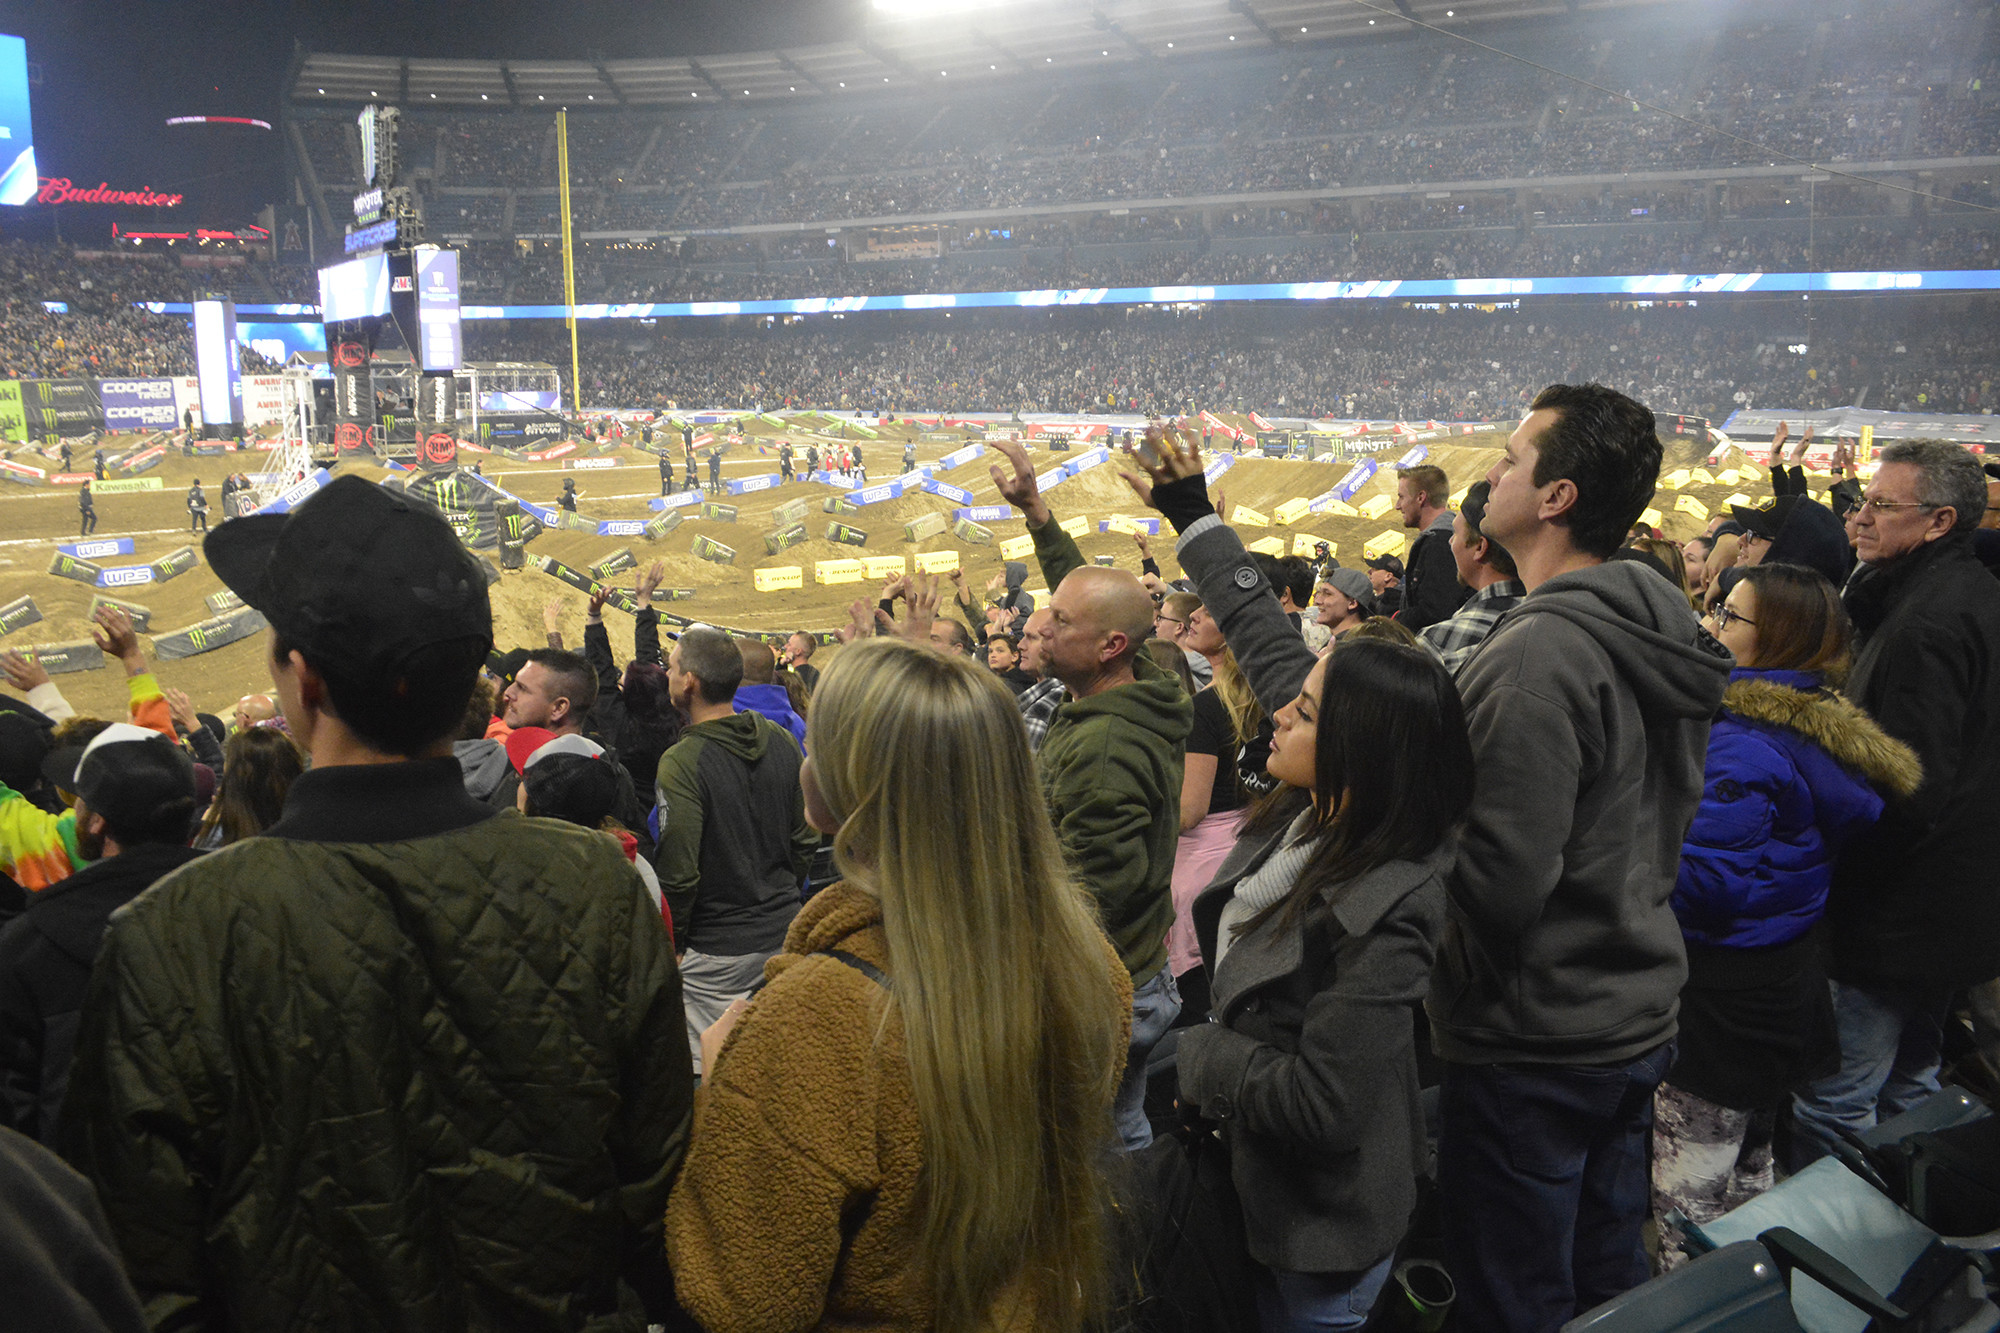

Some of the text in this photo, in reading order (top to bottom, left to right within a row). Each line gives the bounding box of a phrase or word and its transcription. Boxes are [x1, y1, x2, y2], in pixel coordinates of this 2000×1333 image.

[38, 177, 183, 206] Budweiser
[102, 381, 172, 393] COOPER
[106, 406, 175, 418] COOPER
[141, 416, 175, 424] TIRES
[95, 481, 151, 491] Kawasaki
[743, 479, 770, 491] WPS
[286, 479, 319, 505] WPS
[863, 487, 892, 503] WPS
[937, 483, 964, 501] WPS
[664, 494, 693, 507] WPS
[608, 522, 643, 535] WPS
[76, 542, 119, 557] WPS
[105, 569, 152, 585] WPS
